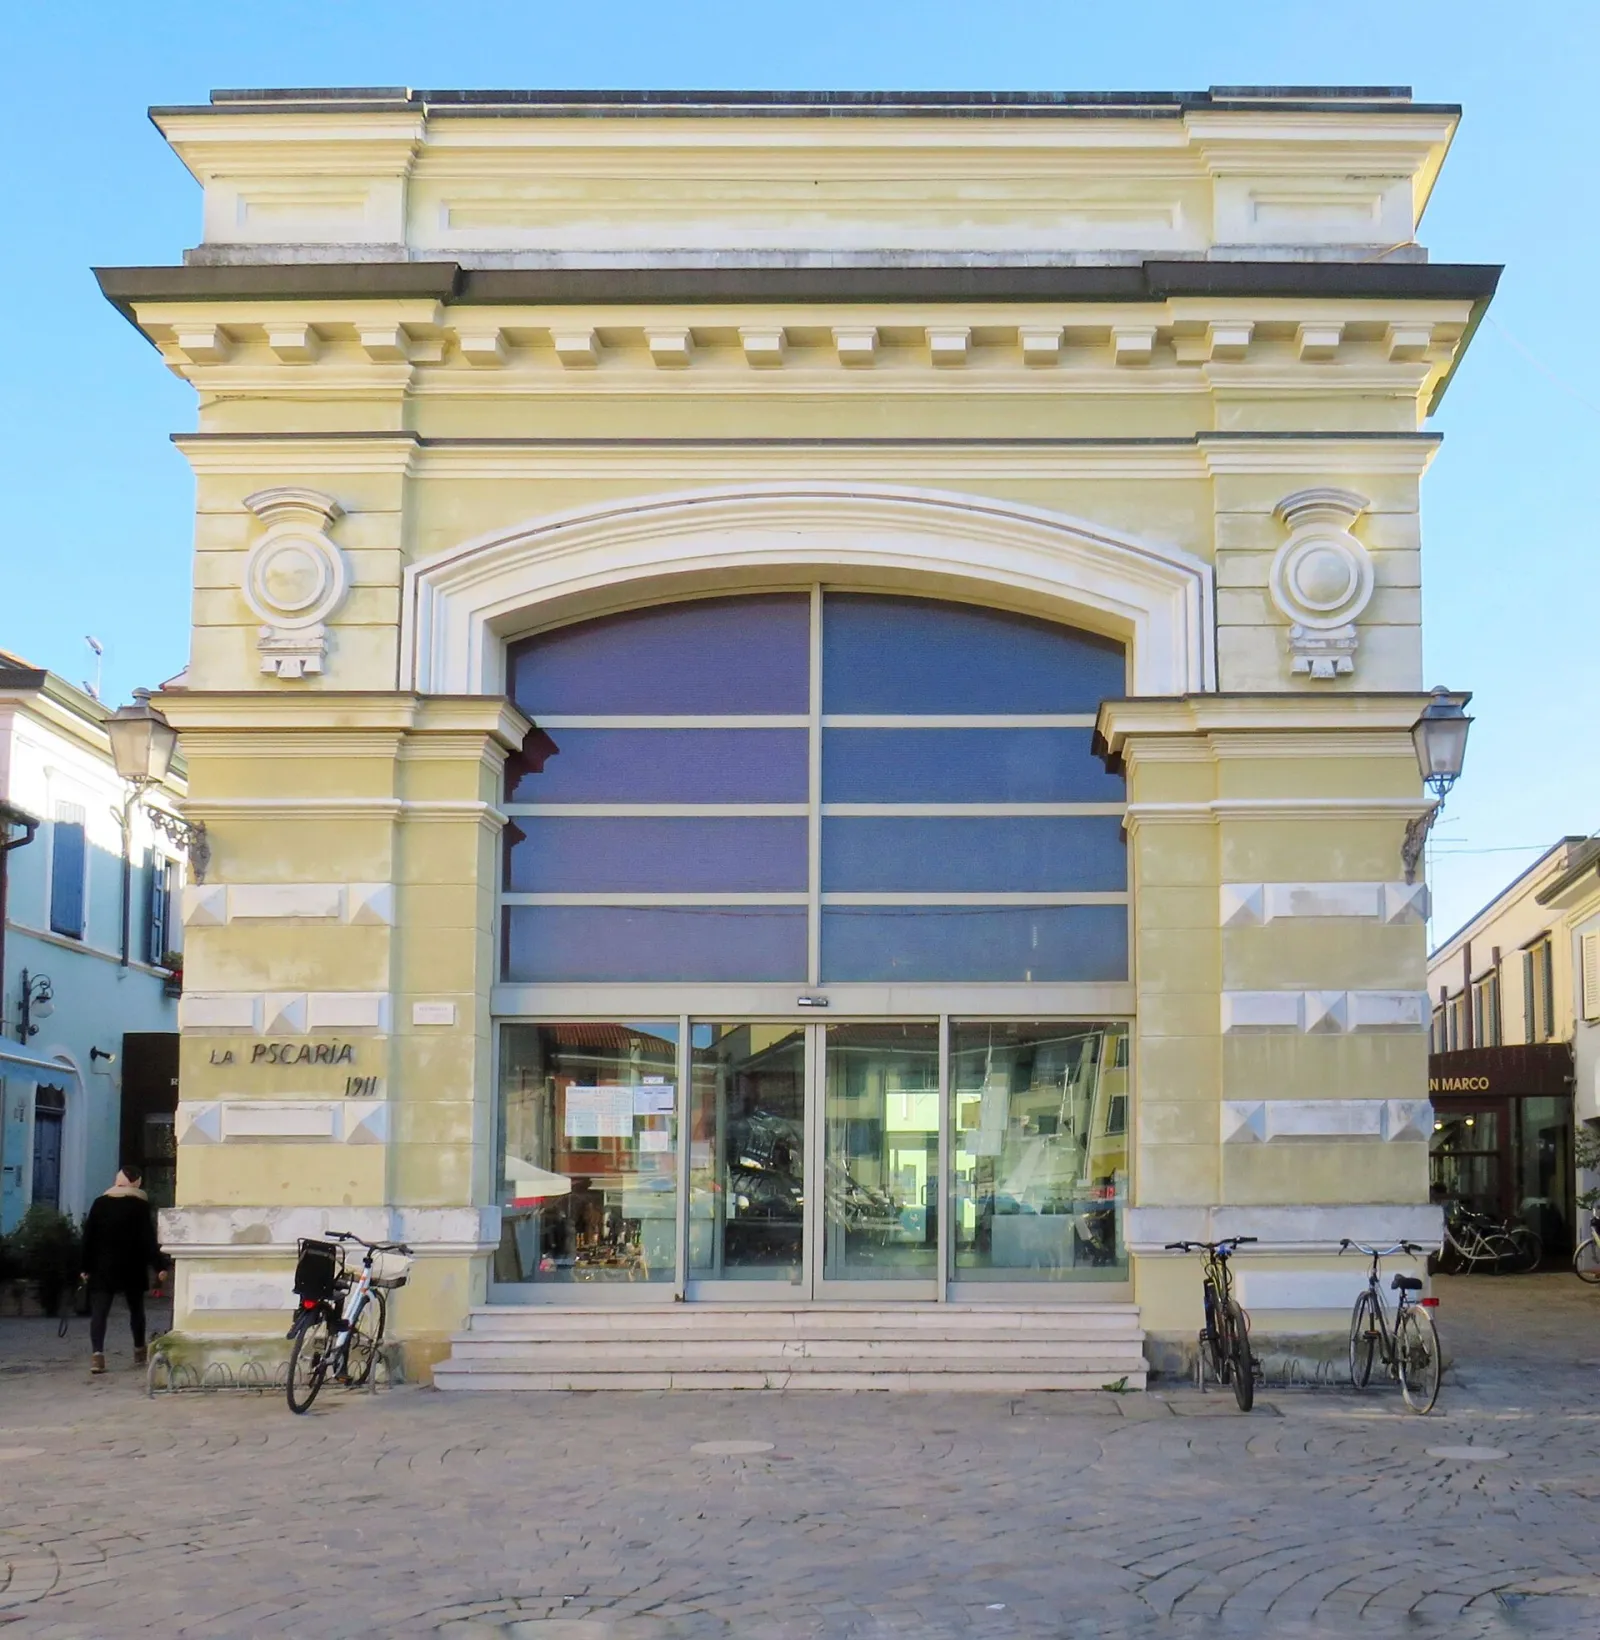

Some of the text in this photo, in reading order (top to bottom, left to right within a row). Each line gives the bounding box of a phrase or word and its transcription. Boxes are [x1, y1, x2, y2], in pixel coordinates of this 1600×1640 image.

[209, 1049, 233, 1065] LA
[345, 1076, 377, 1097] 1911
[1442, 1077, 1489, 1090] MARCO
